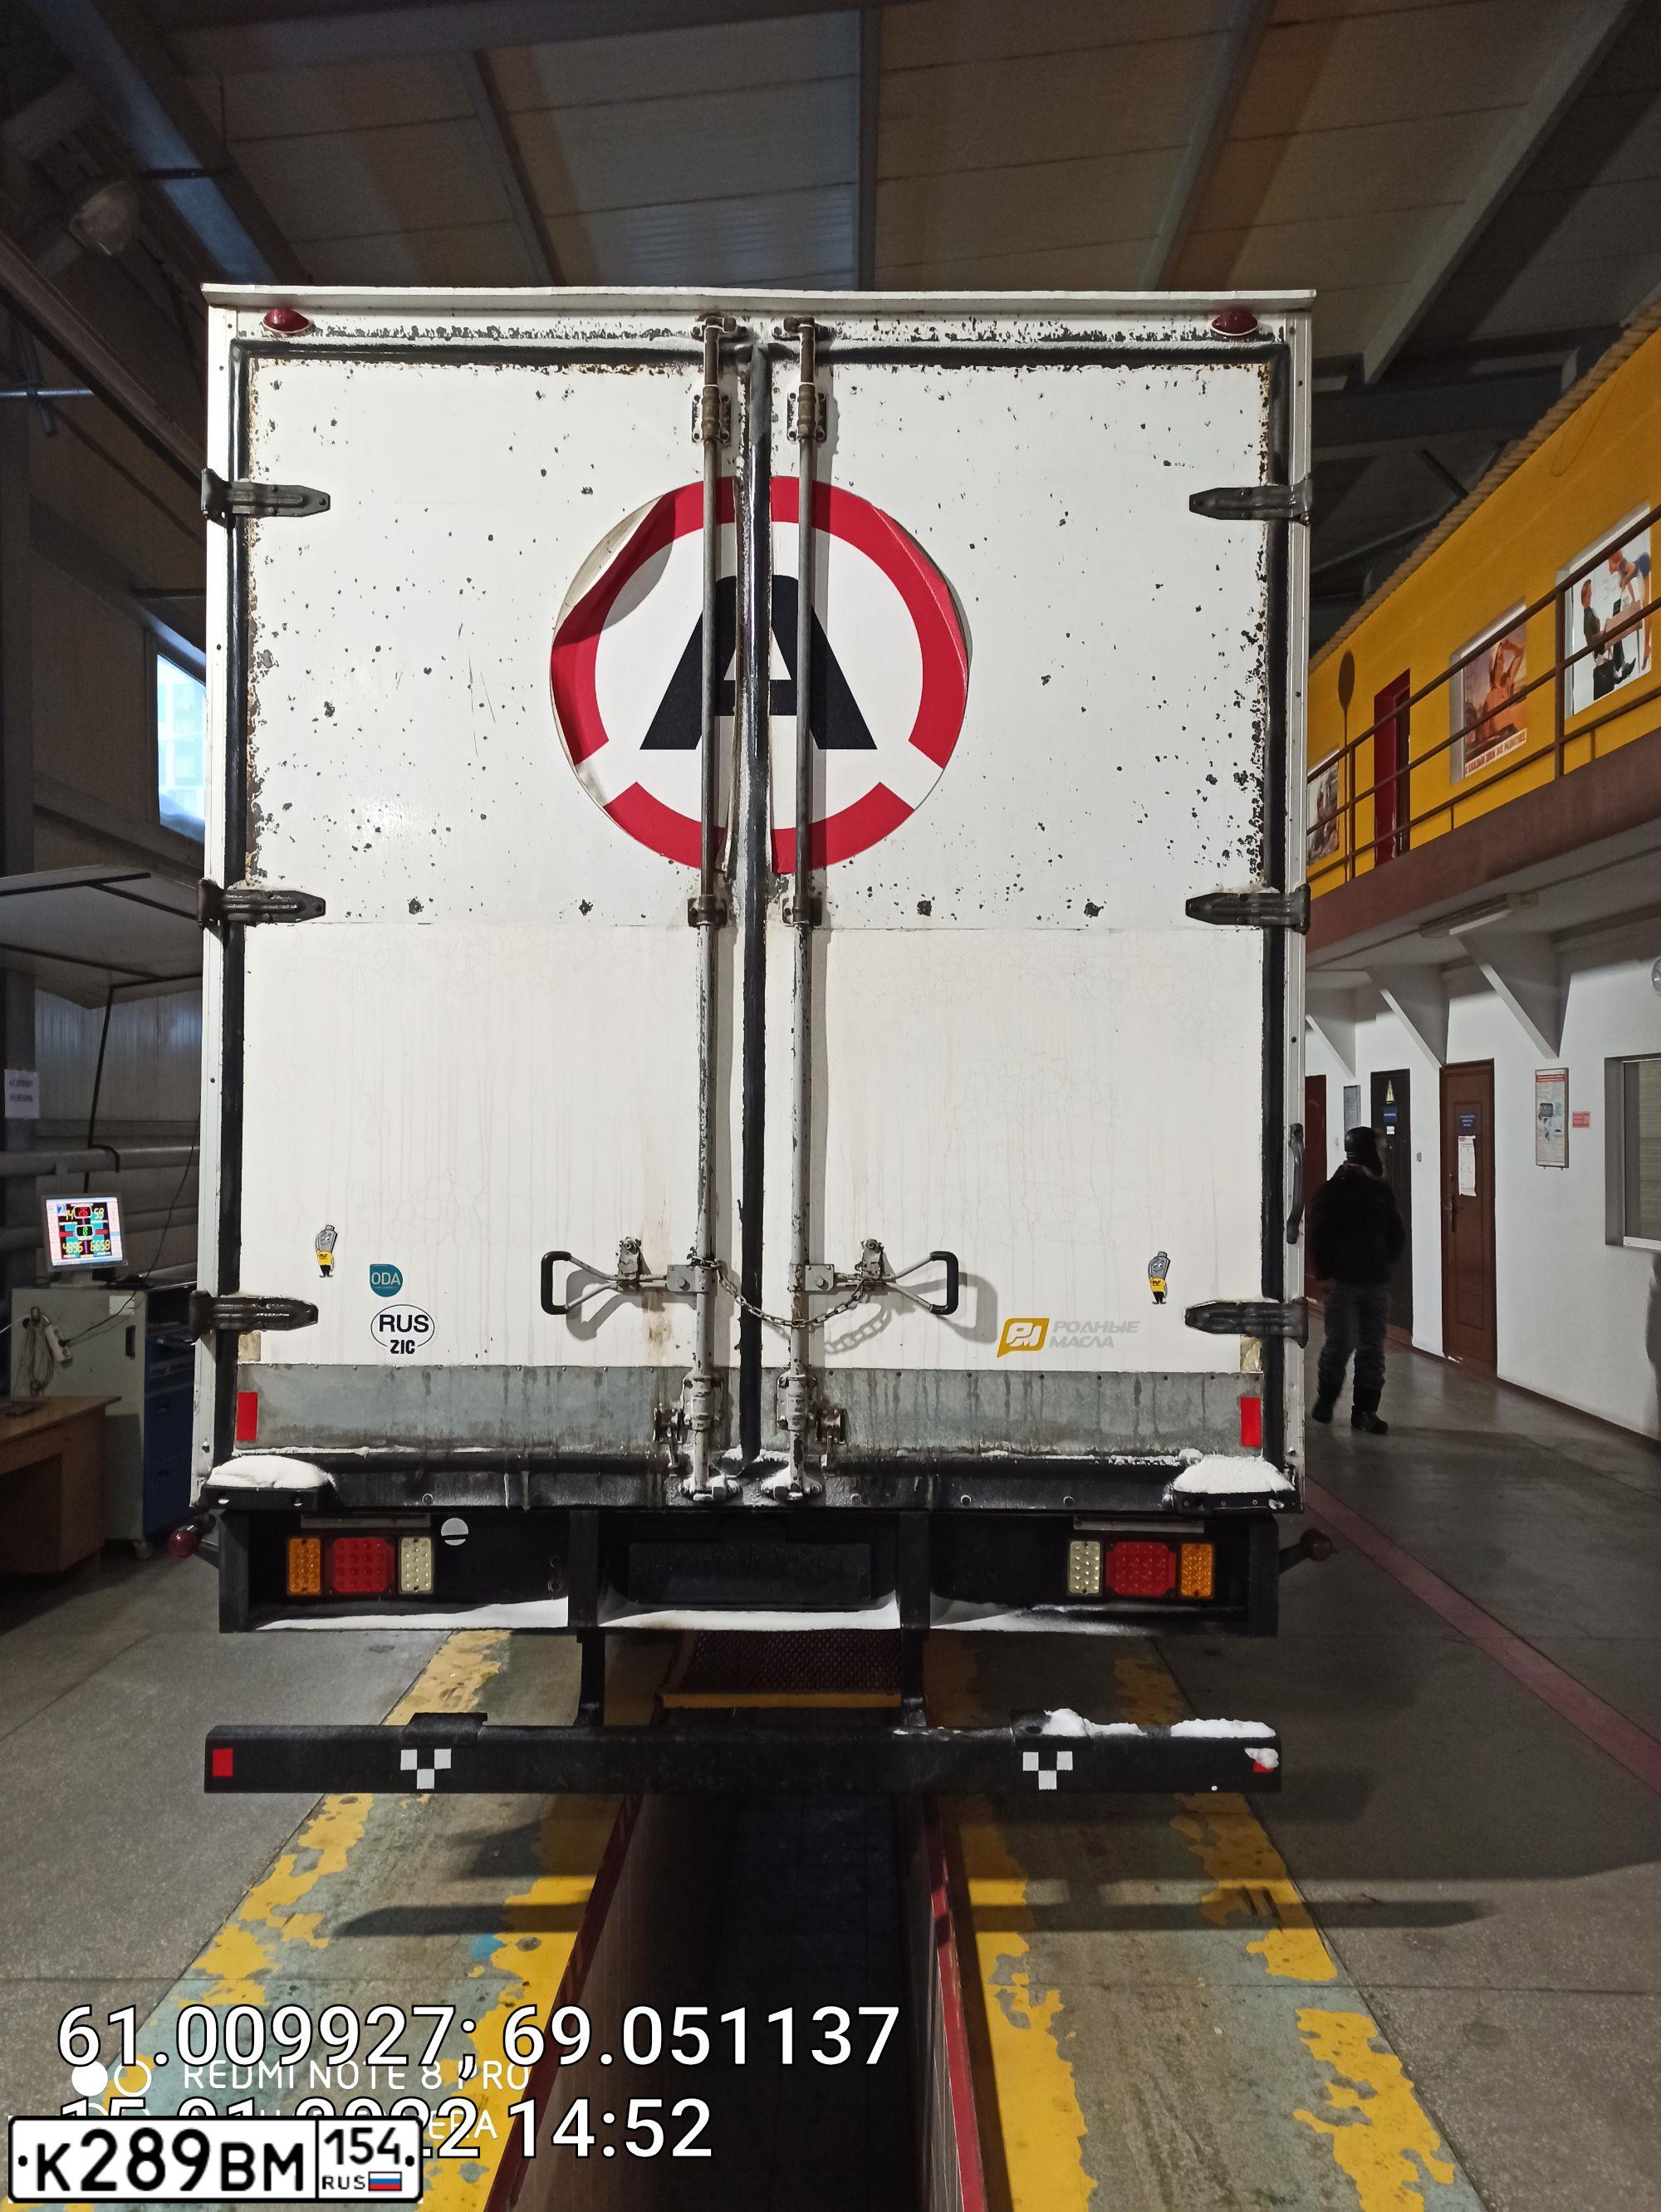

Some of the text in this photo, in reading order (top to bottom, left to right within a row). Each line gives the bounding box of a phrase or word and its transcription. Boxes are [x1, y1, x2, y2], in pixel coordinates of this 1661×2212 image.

[371, 1272, 401, 1286] ODA
[379, 1314, 429, 1333] RUS
[1052, 1321, 1140, 1334] РОДНЫЕ
[390, 1339, 415, 1355] ZIC
[1048, 1336, 1115, 1348] МАСЛА
